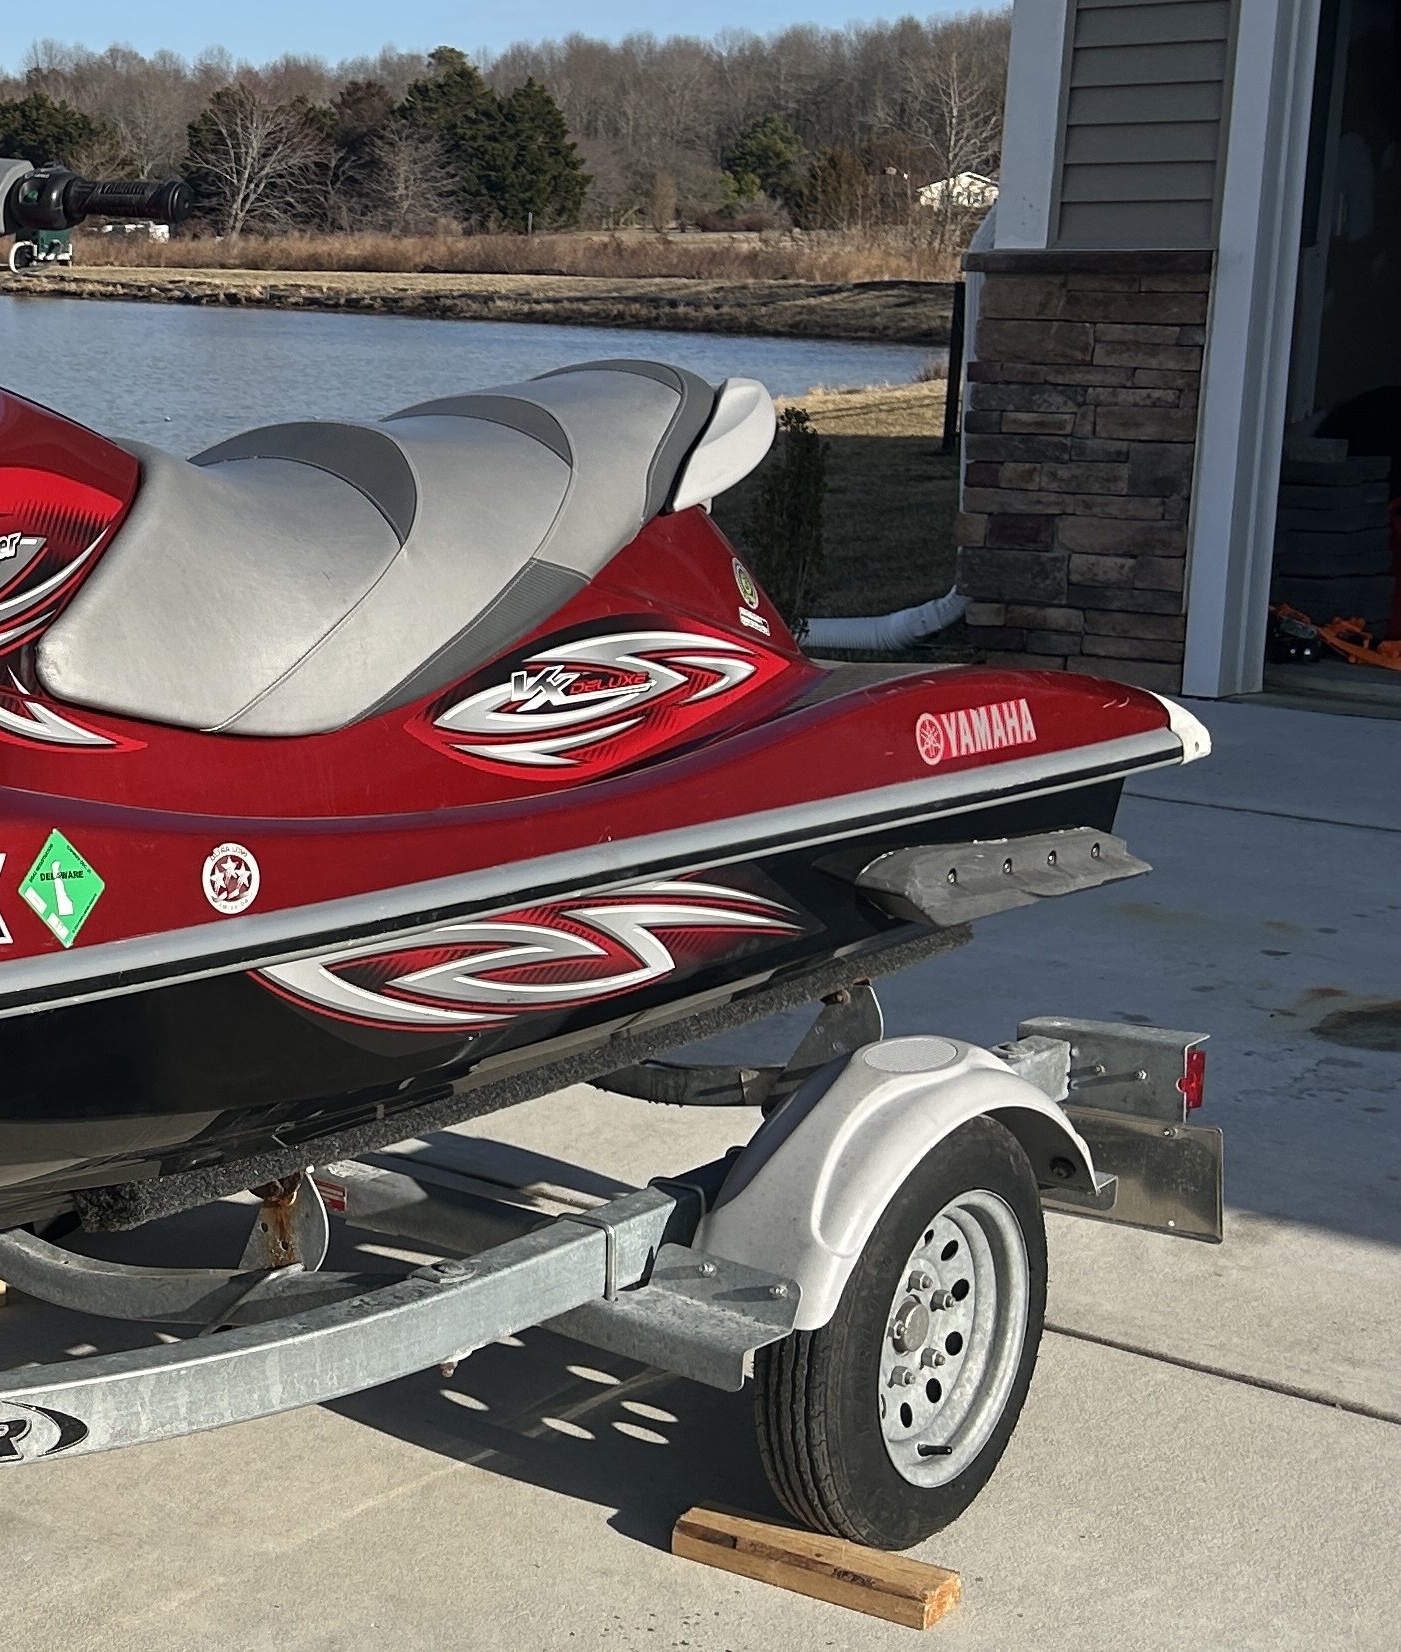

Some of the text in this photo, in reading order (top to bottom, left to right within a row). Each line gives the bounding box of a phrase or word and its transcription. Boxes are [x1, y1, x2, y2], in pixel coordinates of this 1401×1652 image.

[511, 665, 648, 712] VX DELUXE
[940, 699, 1037, 757] YAMAHA
[39, 871, 84, 882] DELAWARE
